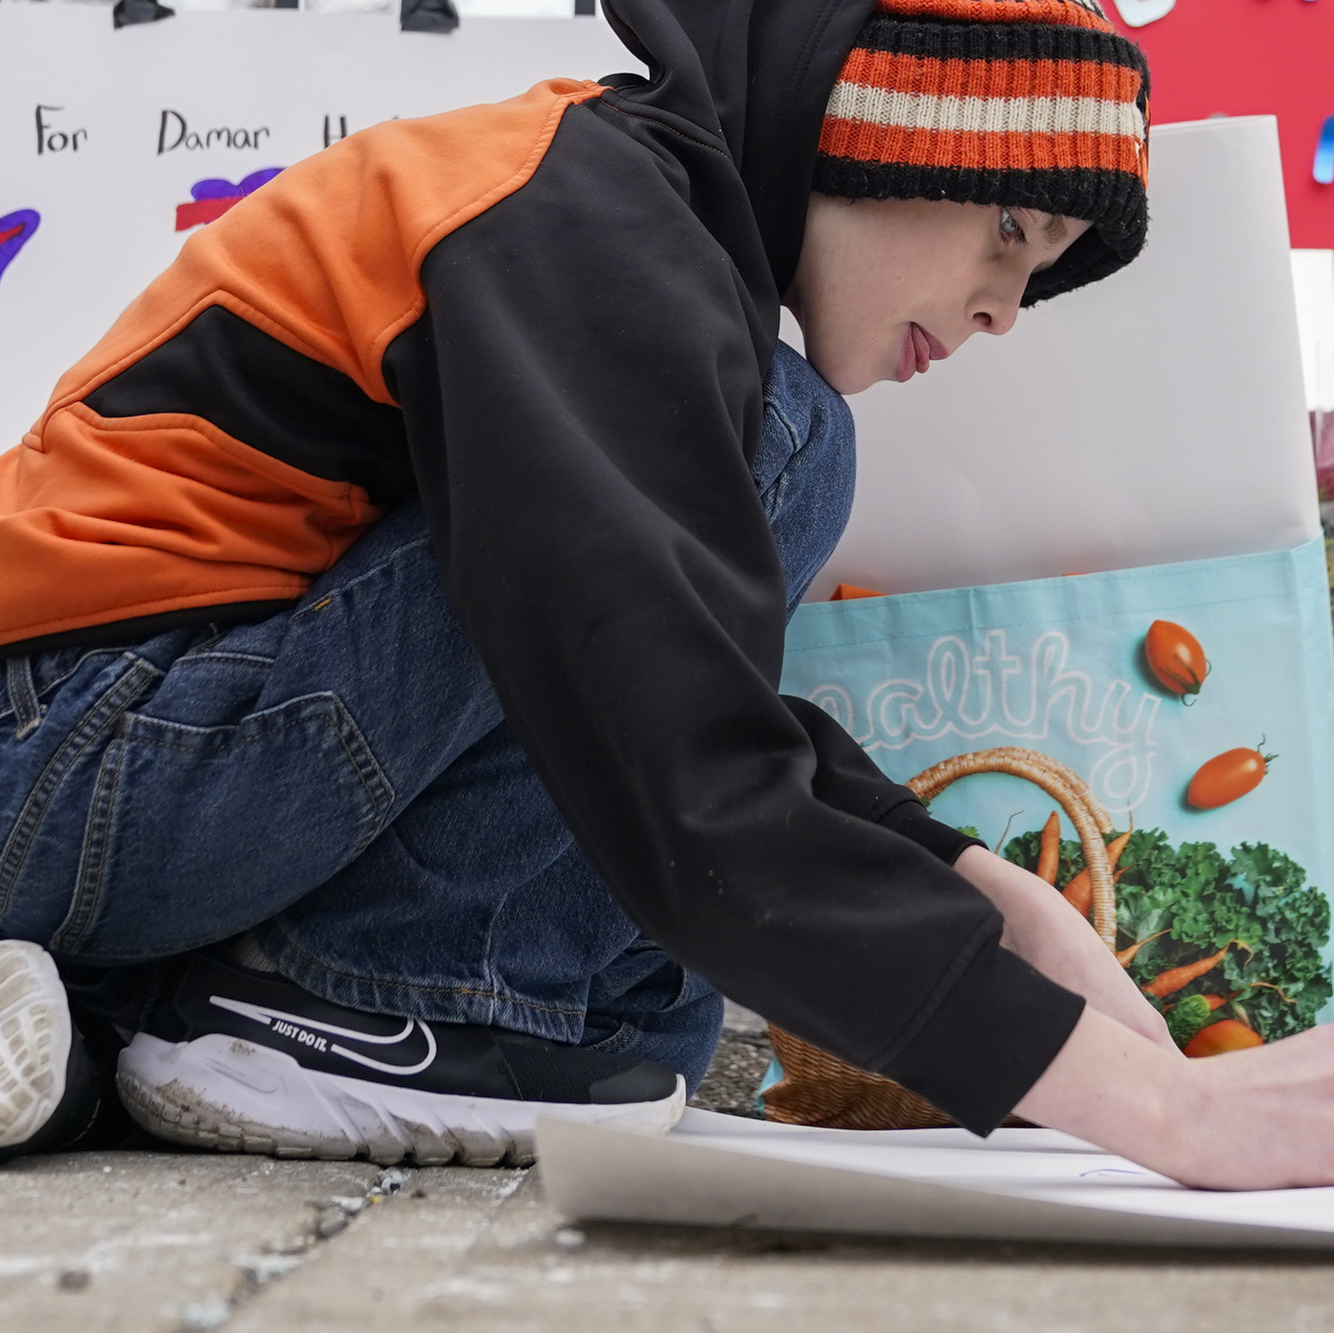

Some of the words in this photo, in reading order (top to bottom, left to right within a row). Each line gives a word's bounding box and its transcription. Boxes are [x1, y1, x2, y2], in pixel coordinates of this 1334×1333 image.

[34, 104, 89, 154] For
[156, 109, 272, 156] Damar
[271, 1019, 300, 1039] JUST
[297, 1029, 316, 1047] DO
